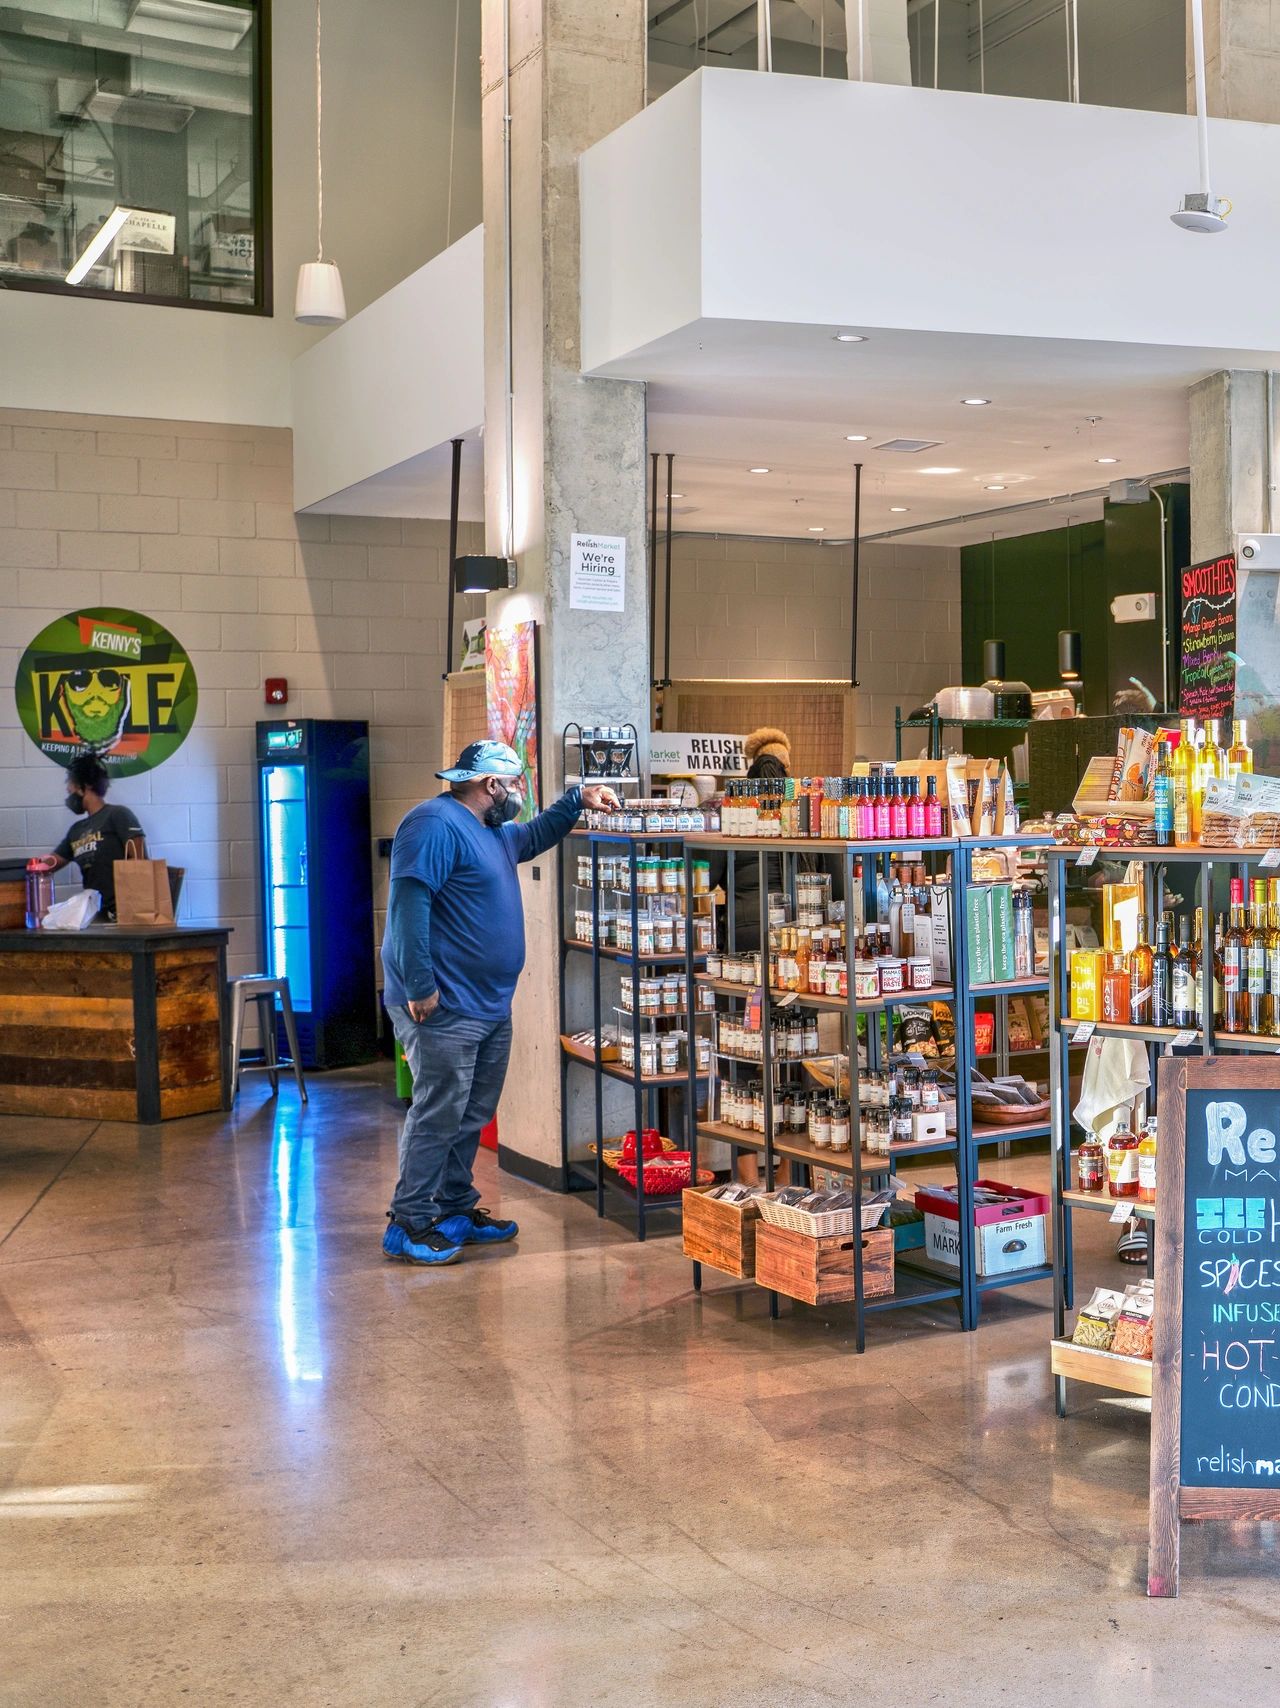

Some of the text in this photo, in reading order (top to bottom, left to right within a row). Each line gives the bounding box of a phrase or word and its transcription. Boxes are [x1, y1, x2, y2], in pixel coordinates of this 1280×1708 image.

[582, 552, 615, 563] We're
[581, 563, 615, 576] Hiring
[1182, 558, 1236, 598] SMOOTHIES
[91, 631, 142, 655] KENNY'S
[38, 672, 178, 738] KLE
[42, 742, 70, 754] KEEPING
[691, 738, 743, 755] RELISH
[687, 754, 749, 771] MARKET
[1075, 966, 1092, 974] THE
[1071, 982, 1096, 990] OLIVE
[1076, 997, 1090, 1005] OIL
[1196, 1197, 1265, 1229] ICE
[996, 1221, 1033, 1234] Farm Fresh
[933, 1233, 960, 1256] MARK
[1198, 1229, 1262, 1244] COLD
[1202, 1339, 1275, 1372] HOT
